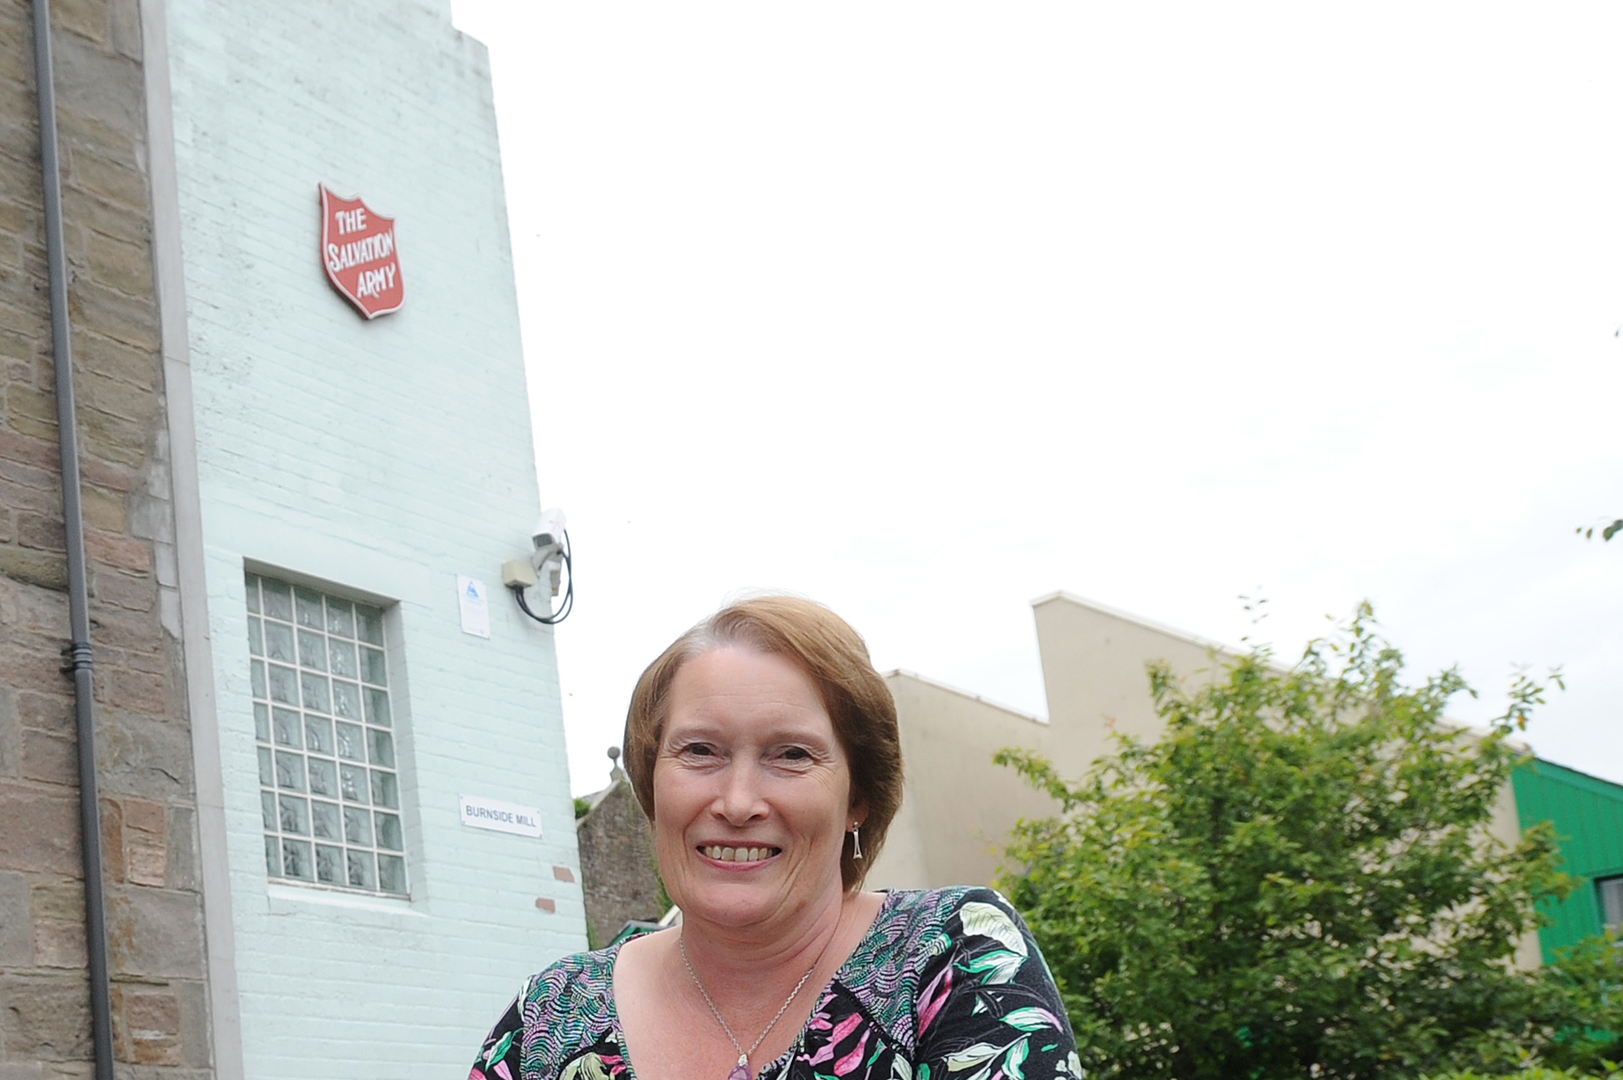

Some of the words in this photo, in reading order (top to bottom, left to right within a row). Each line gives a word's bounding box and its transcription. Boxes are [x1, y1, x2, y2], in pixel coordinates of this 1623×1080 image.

[335, 207, 367, 235] THE
[328, 228, 393, 272] SALVATION
[356, 262, 396, 299] ARMY
[465, 804, 514, 824] BURNSIDE
[515, 814, 536, 828] MILL
